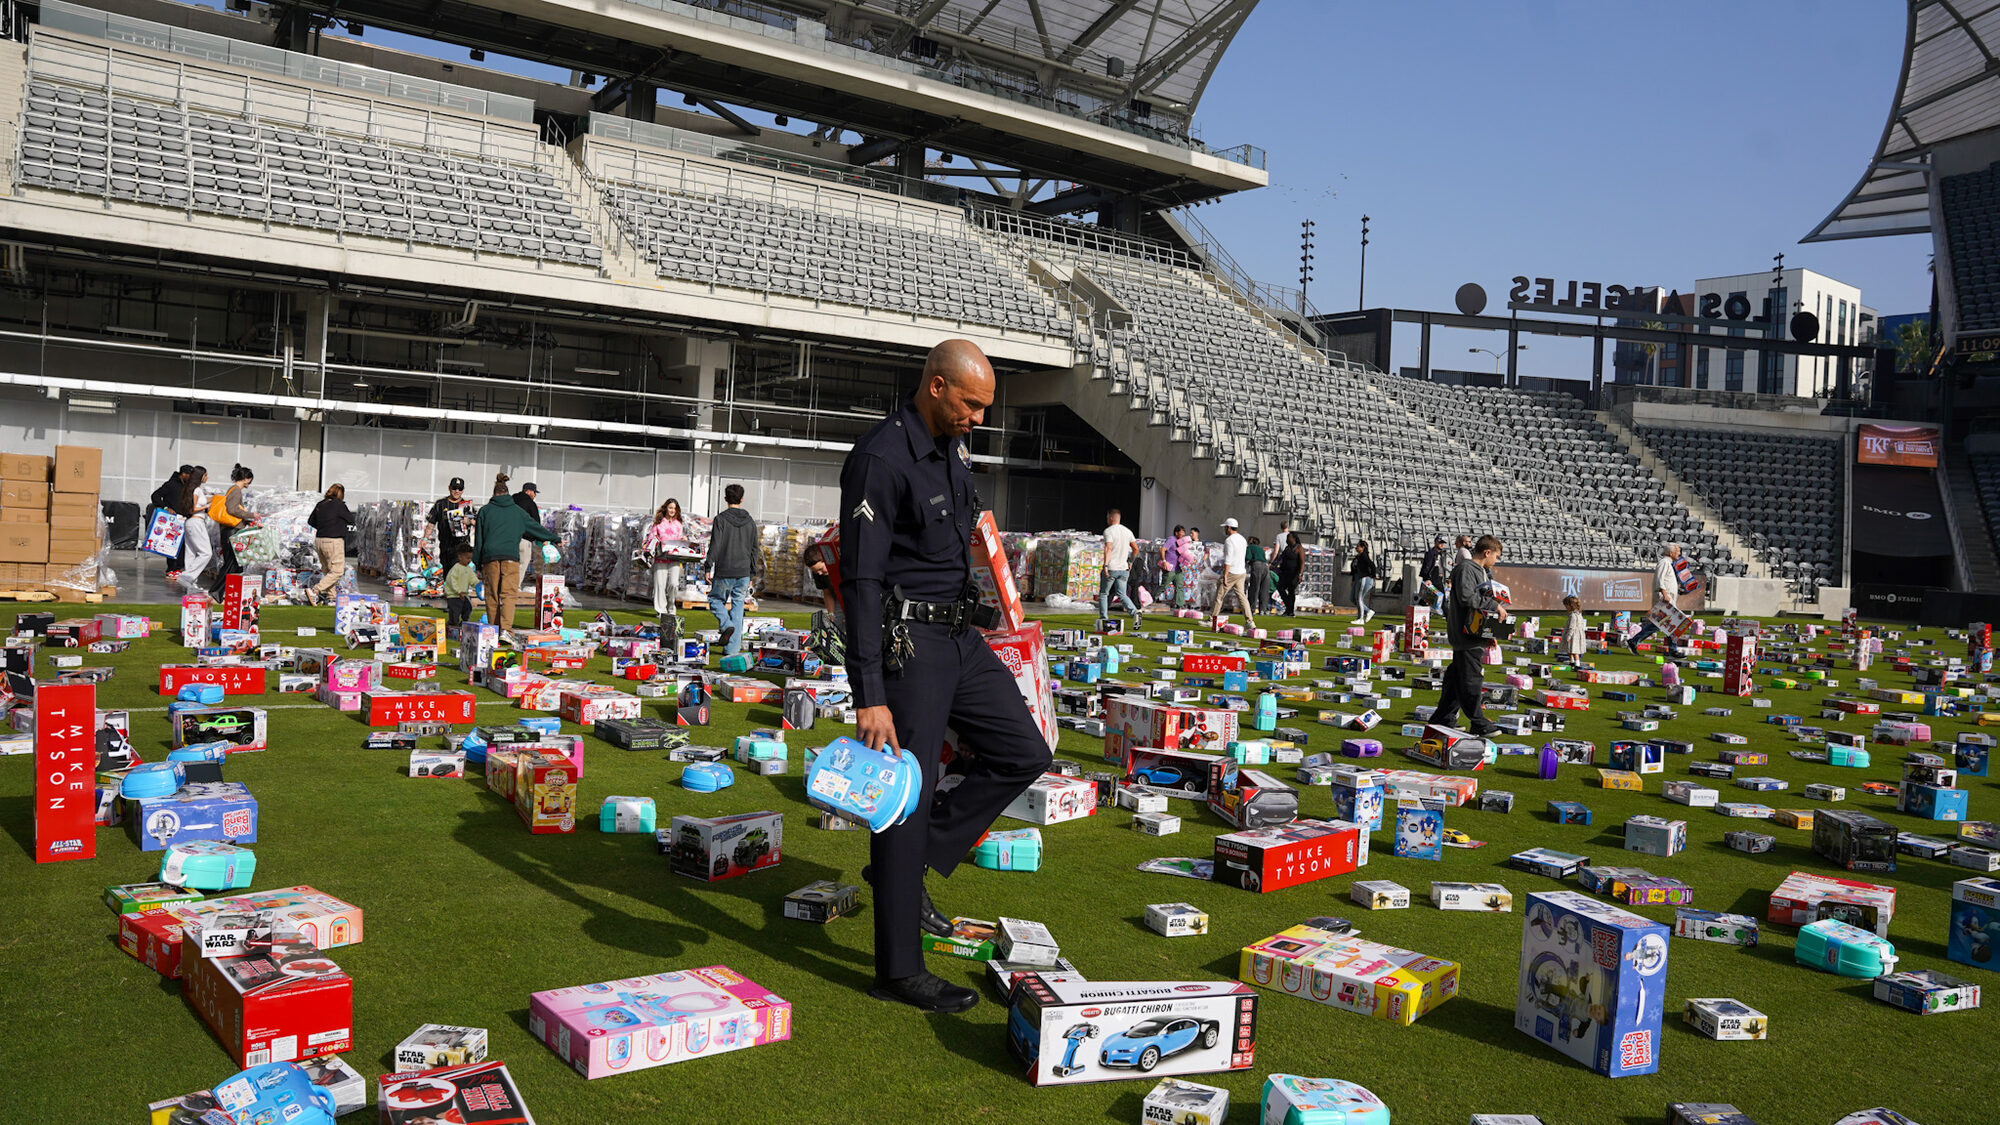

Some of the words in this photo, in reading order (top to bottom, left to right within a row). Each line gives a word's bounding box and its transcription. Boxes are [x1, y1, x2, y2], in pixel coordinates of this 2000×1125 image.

[226, 584, 234, 626] TYSON
[191, 673, 252, 681] TYSON
[395, 701, 435, 709] MIKE
[385, 710, 445, 720] TYSON
[50, 709, 65, 809] TYSON
[70, 725, 83, 790] MIKE
[883, 770, 893, 778] 19
[224, 814, 248, 828] Band
[225, 823, 249, 836] Kid's
[1217, 839, 1230, 848] MIKE
[1231, 842, 1248, 852] TYSON
[1286, 845, 1323, 863] MIKE
[1276, 857, 1332, 880] TYSON
[205, 940, 236, 948] WARS
[933, 942, 978, 957] SUBWAY
[1598, 931, 1608, 967] Band
[1607, 933, 1617, 969] Kid's
[193, 960, 217, 998] MIKE
[1126, 988, 1172, 996] BUGATTI
[188, 973, 223, 1030] TYSON
[1104, 1006, 1138, 1016] BUGATTI
[1141, 1004, 1173, 1014] CHIRON
[773, 1008, 782, 1039] QUEEN
[1621, 1033, 1633, 1067] Kid's
[1632, 1032, 1645, 1065] Band
[399, 1056, 425, 1064] WARS
[1146, 1106, 1173, 1115] STAR
[1146, 1111, 1173, 1122] WARS
